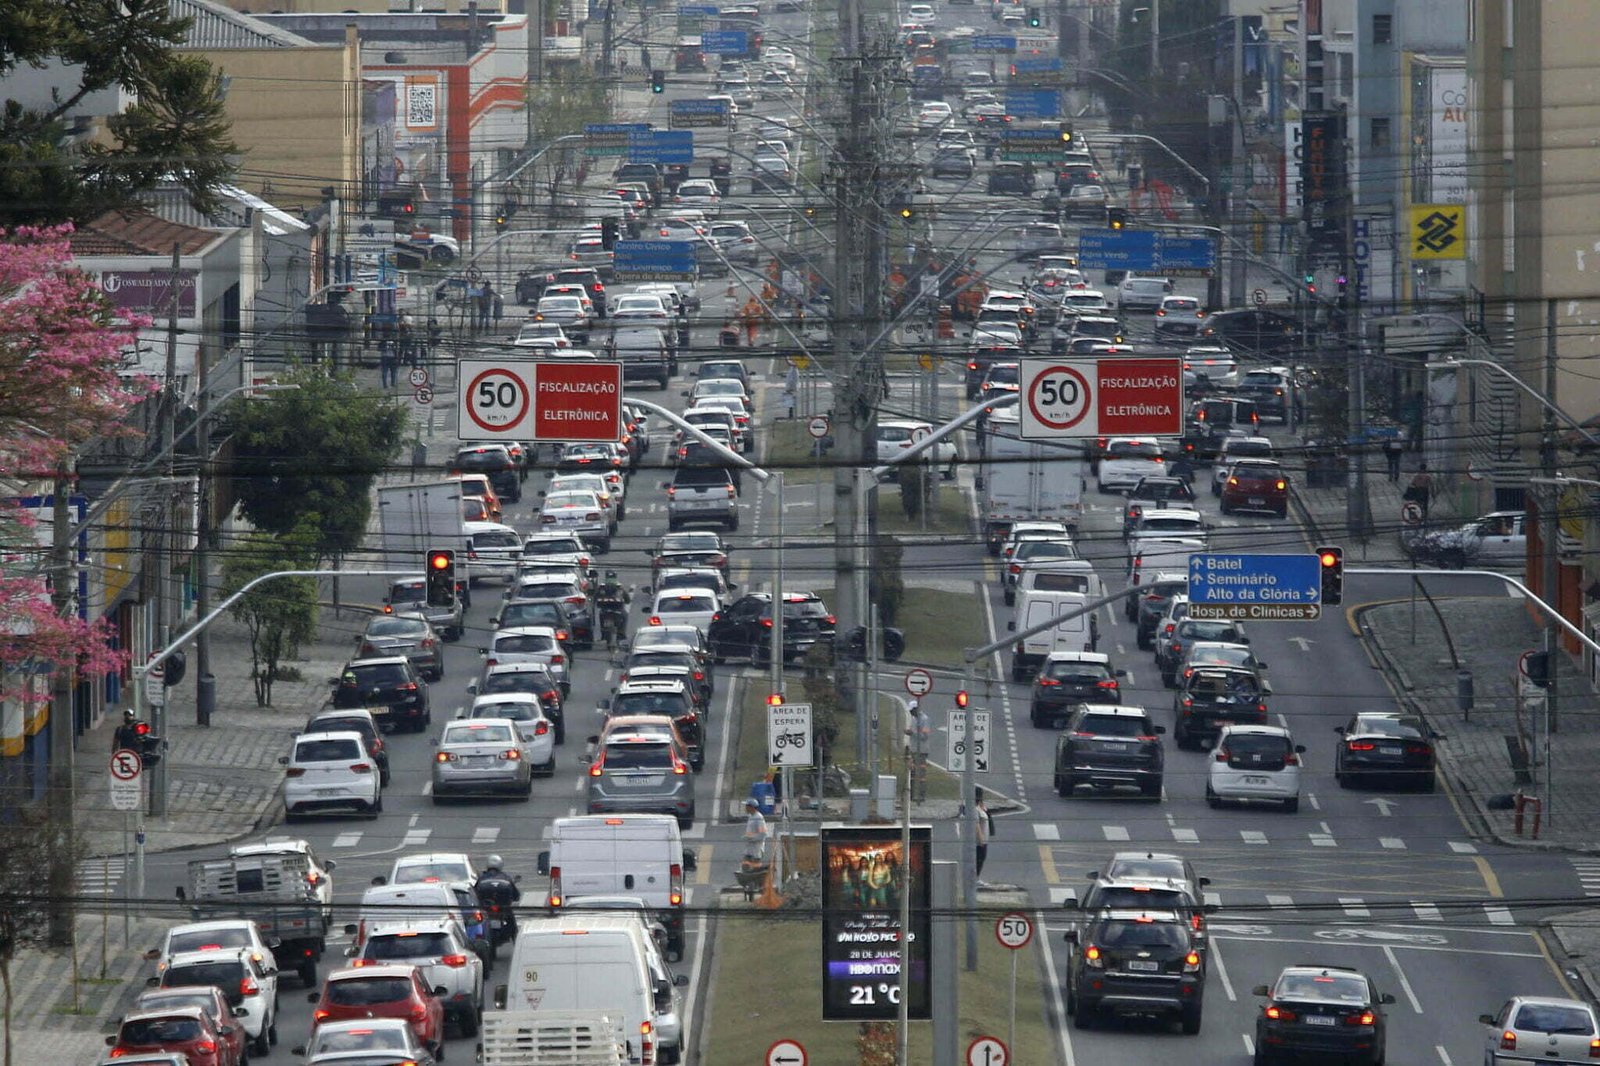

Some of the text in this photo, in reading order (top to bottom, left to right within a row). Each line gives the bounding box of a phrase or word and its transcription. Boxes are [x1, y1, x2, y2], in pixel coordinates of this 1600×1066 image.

[539, 381, 616, 395] FISCALIZAÇÃO
[1100, 376, 1177, 389] FISCALIZAÇÃO
[479, 382, 517, 409] 50
[1042, 379, 1079, 406] 50
[544, 408, 609, 421] ELETRÔNICA
[1106, 403, 1172, 416] ELETRÔNICA
[1206, 558, 1242, 570] Batel
[1206, 573, 1277, 585] Seminário
[1206, 587, 1301, 600] Alto da Glória
[796, 706, 808, 715] DE
[774, 718, 806, 726] ESPERA
[1002, 920, 1027, 937] 50
[853, 931, 879, 942] NOVO
[862, 951, 873, 959] DE
[526, 971, 538, 983] 90
[850, 985, 876, 1005] 21
